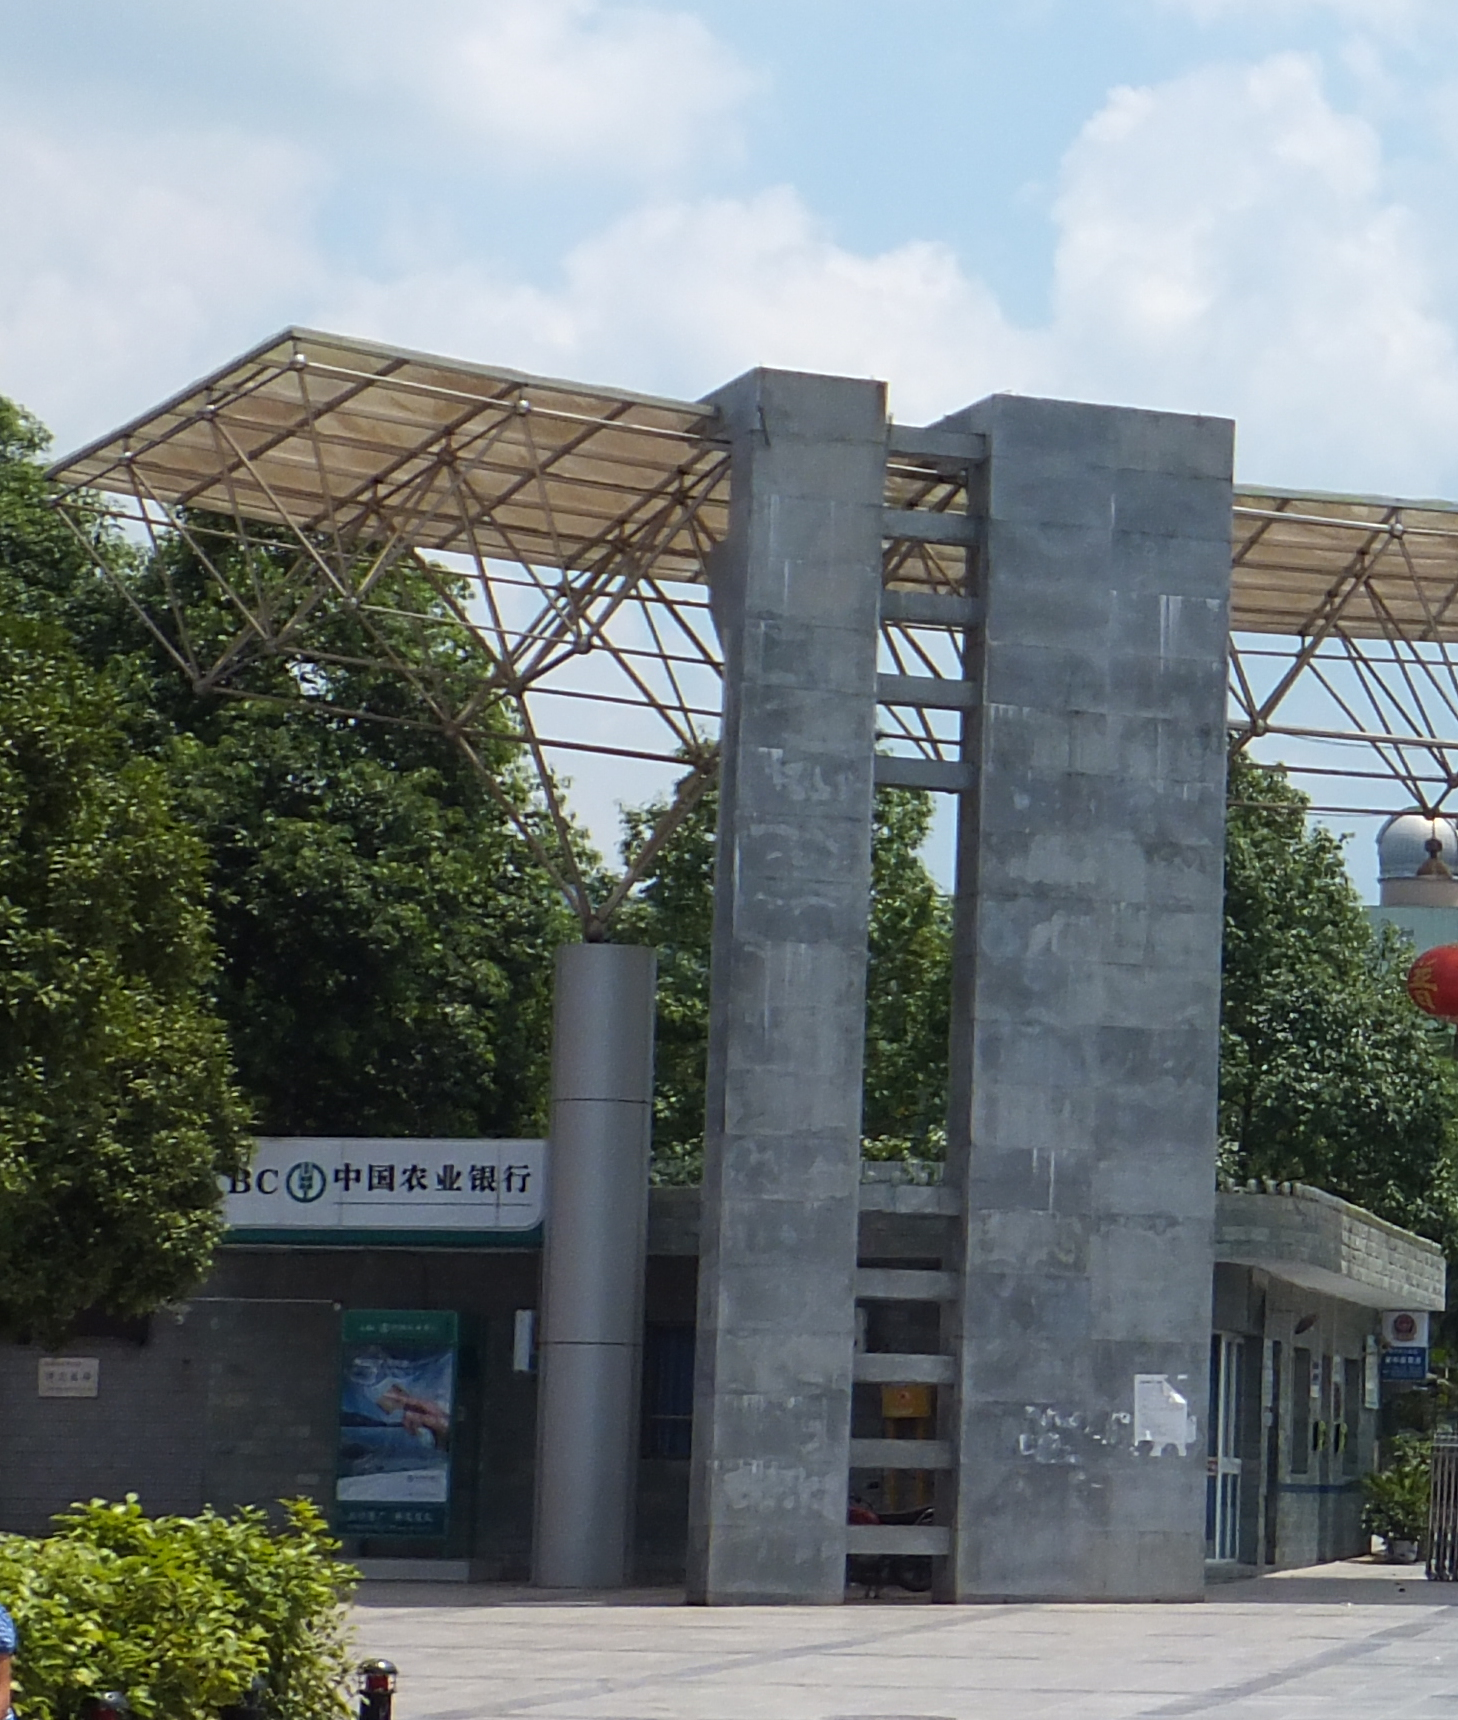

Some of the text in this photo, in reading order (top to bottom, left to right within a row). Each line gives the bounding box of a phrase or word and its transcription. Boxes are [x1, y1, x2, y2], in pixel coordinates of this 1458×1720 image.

[228, 1168, 279, 1195] BC
[333, 1163, 532, 1193] 中国农业银行
